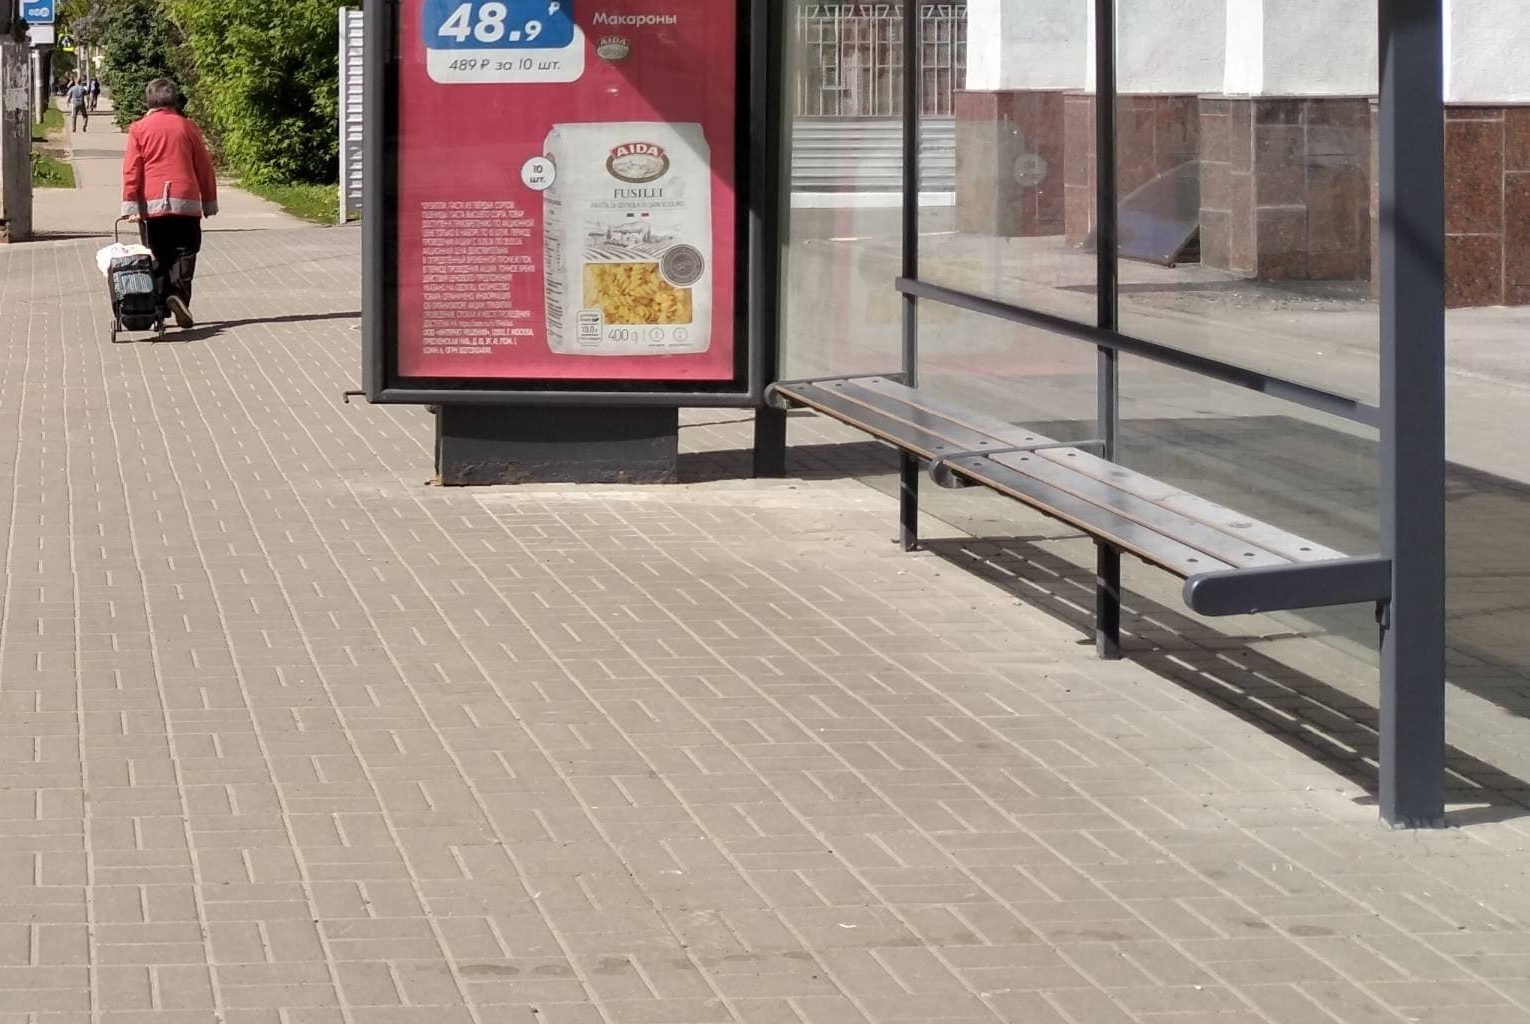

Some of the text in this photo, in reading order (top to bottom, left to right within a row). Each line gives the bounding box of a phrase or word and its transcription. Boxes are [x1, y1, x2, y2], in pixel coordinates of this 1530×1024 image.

[592, 11, 677, 28] Макароны
[495, 61, 512, 71] за
[518, 59, 533, 71] 10
[537, 61, 561, 71] шт.
[616, 143, 660, 157] AIDA
[533, 165, 544, 174] 10
[613, 188, 663, 199] FUSILLI
[608, 328, 629, 342] 400
